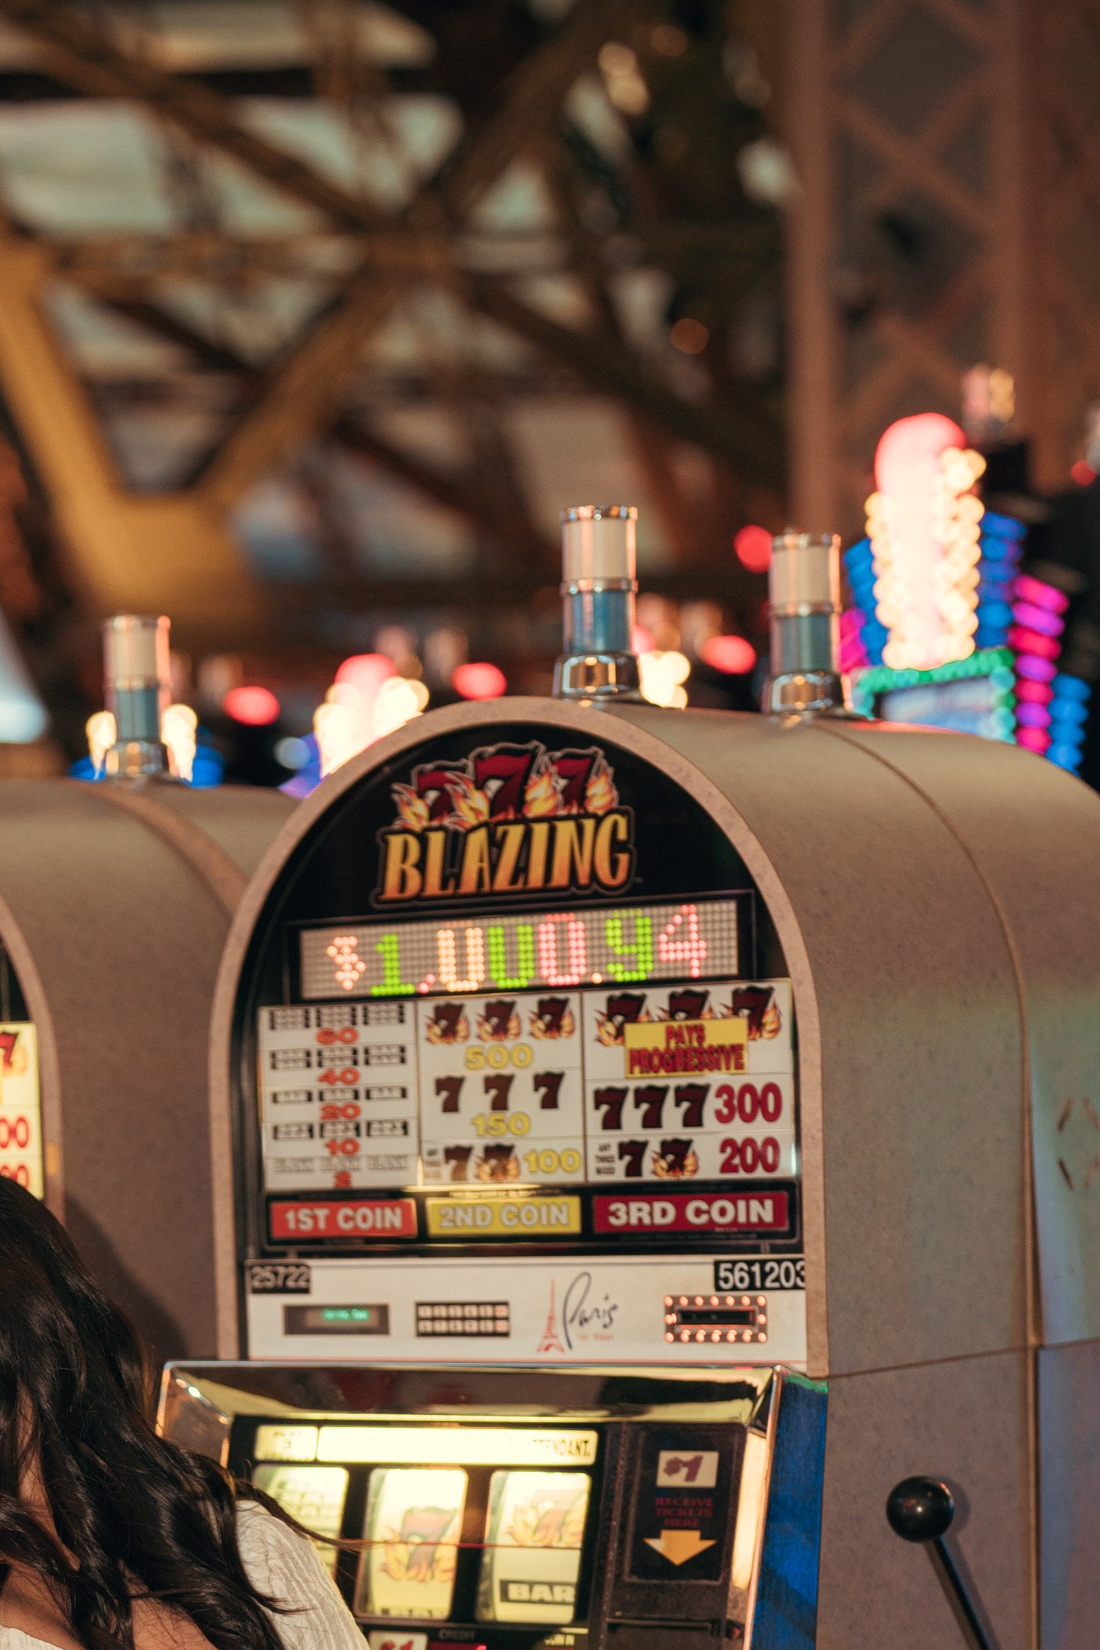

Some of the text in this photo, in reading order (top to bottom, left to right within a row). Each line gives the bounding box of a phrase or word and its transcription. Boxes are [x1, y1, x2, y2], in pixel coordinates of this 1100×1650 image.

[378, 814, 631, 900] BLAZING
[665, 1024, 705, 1045] PAYS
[464, 1044, 534, 1070] 500
[629, 1043, 744, 1074] PROGRESSIVE
[317, 1066, 360, 1086] 40
[320, 1103, 361, 1121] 20
[714, 1082, 782, 1124] 300
[471, 1112, 530, 1137] 150
[325, 1138, 360, 1156] 10
[719, 1136, 780, 1174] 200
[523, 1149, 581, 1174] 100
[284, 1206, 402, 1230] 1ST COIN
[440, 1203, 569, 1227] 2ND COIN
[608, 1199, 774, 1226] 3RD COIN
[563, 1271, 618, 1350] Paris
[663, 1454, 704, 1482] $1
[508, 1583, 575, 1601] BAR
